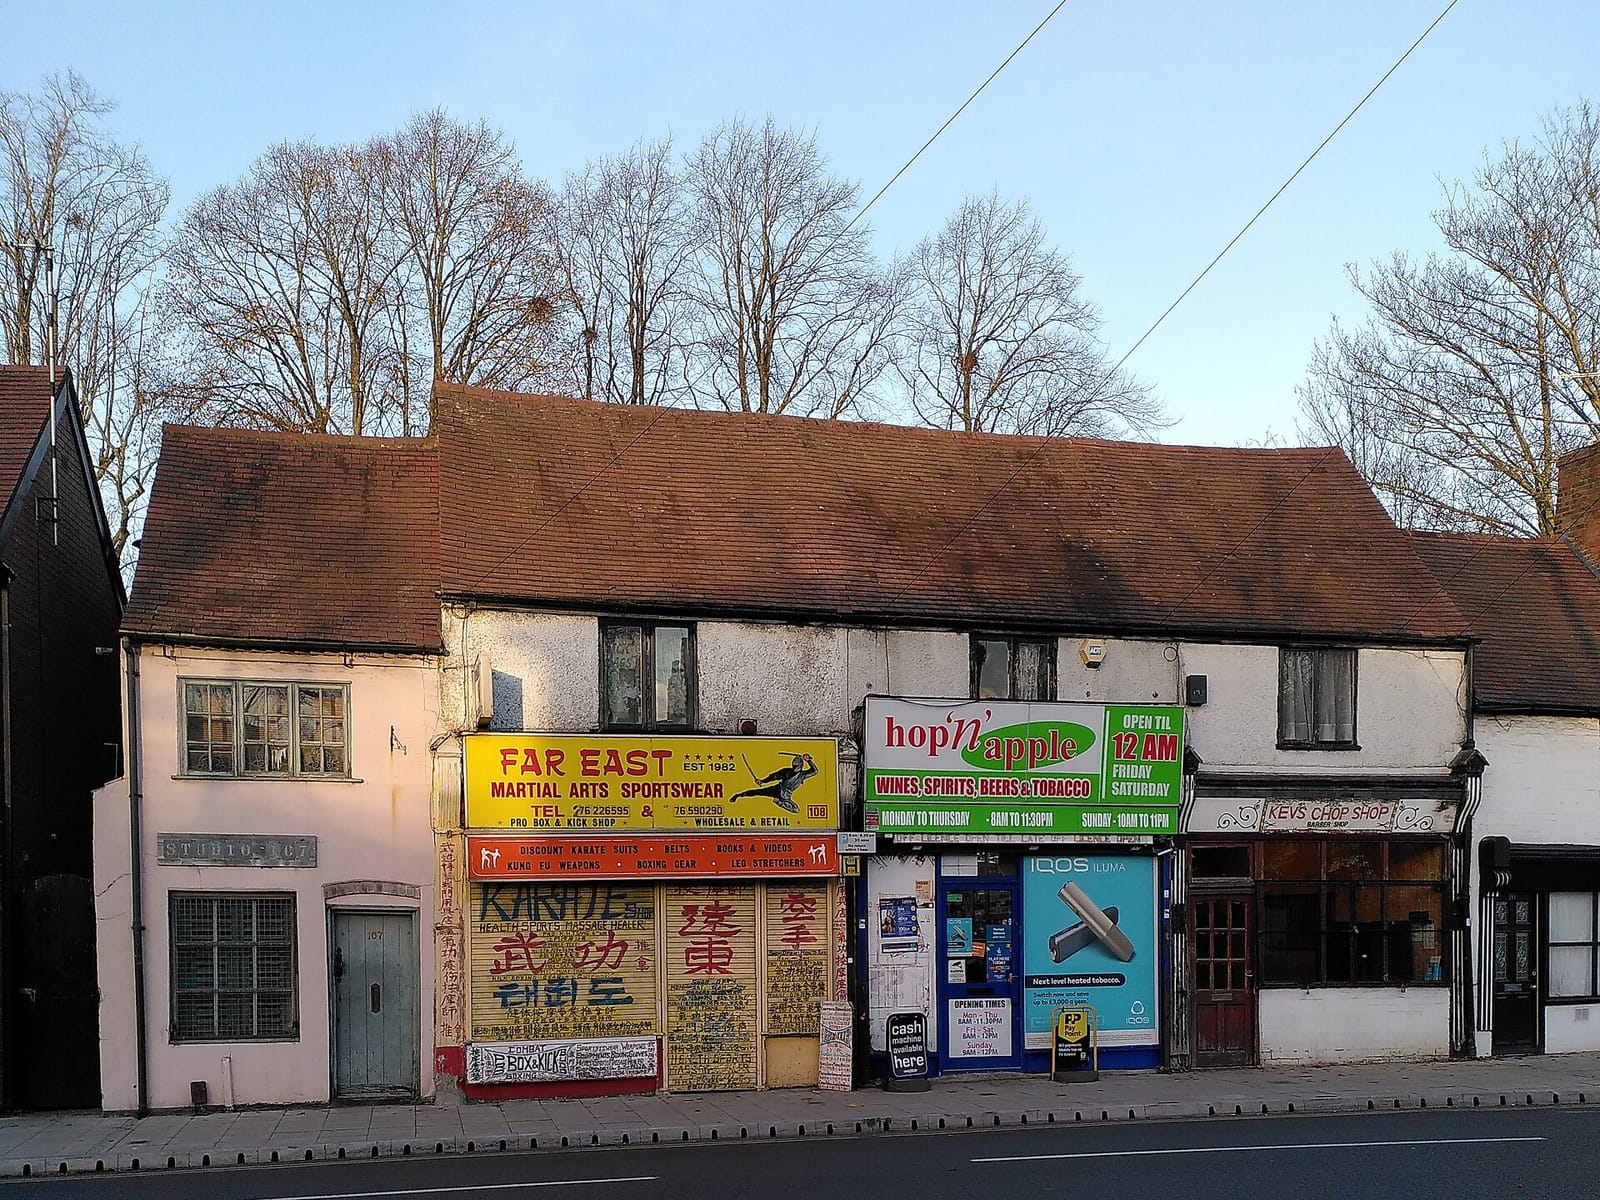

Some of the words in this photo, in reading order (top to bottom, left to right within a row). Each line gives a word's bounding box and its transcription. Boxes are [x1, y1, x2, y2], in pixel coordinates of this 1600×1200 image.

[1123, 714, 1152, 729] OPEN
[1155, 716, 1171, 730] TIL
[885, 716, 949, 757] hop
[985, 730, 1077, 771] apple
[1112, 732, 1138, 760] 12
[1141, 733, 1178, 762] AM
[500, 748, 566, 776] FAR
[580, 748, 672, 777] EAST
[683, 762, 705, 771] EST
[709, 762, 736, 771] 1982
[1112, 764, 1152, 779] FRIDAY
[491, 781, 562, 798] MARTIAL
[569, 782, 609, 798] ARTS
[621, 782, 724, 799] SPORTSWEAR
[876, 776, 922, 797] WINES,
[924, 777, 977, 797] SPIRITS,
[980, 778, 1019, 797] BEERS
[1020, 780, 1030, 796] &
[1032, 779, 1090, 798] TOBACCO
[1111, 781, 1170, 797] SATURDAY
[531, 805, 565, 817] TEL
[593, 806, 629, 815] 226595
[641, 805, 653, 817] &
[808, 806, 826, 817] 108
[1311, 807, 1349, 820] CHOP
[1352, 806, 1389, 820] SHOP
[510, 818, 527, 827] PRO
[533, 818, 550, 827] BOX
[554, 818, 561, 827] &
[567, 818, 588, 827] KICK
[592, 818, 616, 827] SHOP
[694, 817, 745, 826] WHOLESALE
[750, 817, 757, 826] &
[761, 817, 790, 826] RETAIL
[882, 811, 915, 825] MONDAY
[917, 811, 927, 825] TO
[928, 811, 970, 826] THURSDAY
[991, 812, 1008, 826] 8AM
[1009, 812, 1019, 826] TO
[1021, 812, 1053, 827] 11:30PM
[1081, 813, 1111, 827] SUNDAY
[1117, 813, 1137, 828] 10AM
[1139, 814, 1148, 828] TO
[1149, 814, 1169, 828] 11PM
[166, 843, 251, 857] STUDIO
[520, 845, 564, 855] DISCOUNT
[571, 845, 606, 854] KARATE
[613, 845, 639, 854] SUITS
[664, 844, 690, 854] BELTS
[716, 844, 744, 853] BOOKS
[764, 843, 793, 853] VIDEOS
[507, 861, 531, 871] KUNG
[539, 861, 550, 870] FU
[559, 860, 601, 870] WEAPONS
[637, 860, 667, 869] BOXING
[674, 859, 697, 869] GEAR
[731, 859, 747, 868] LEG
[752, 858, 806, 868] STRETCHERS
[1031, 858, 1089, 874] IQOS
[1093, 863, 1126, 872] ILUMA
[481, 881, 628, 921] KARATE
[480, 922, 519, 932] HEALTH
[521, 922, 560, 932] SPORTS
[566, 921, 607, 931] MASSAGE
[610, 920, 646, 930] HEALER
[367, 931, 384, 940] 107
[1033, 977, 1050, 985] Next
[1051, 977, 1067, 985] level
[1067, 976, 1091, 984] heated
[954, 1000, 983, 1008] OPENING
[985, 999, 1006, 1008] TIMES
[892, 1020, 922, 1035] cash
[1126, 1017, 1150, 1025] IQOS
[892, 1035, 922, 1044] machine
[893, 1044, 923, 1054] available
[894, 1055, 924, 1068] here
